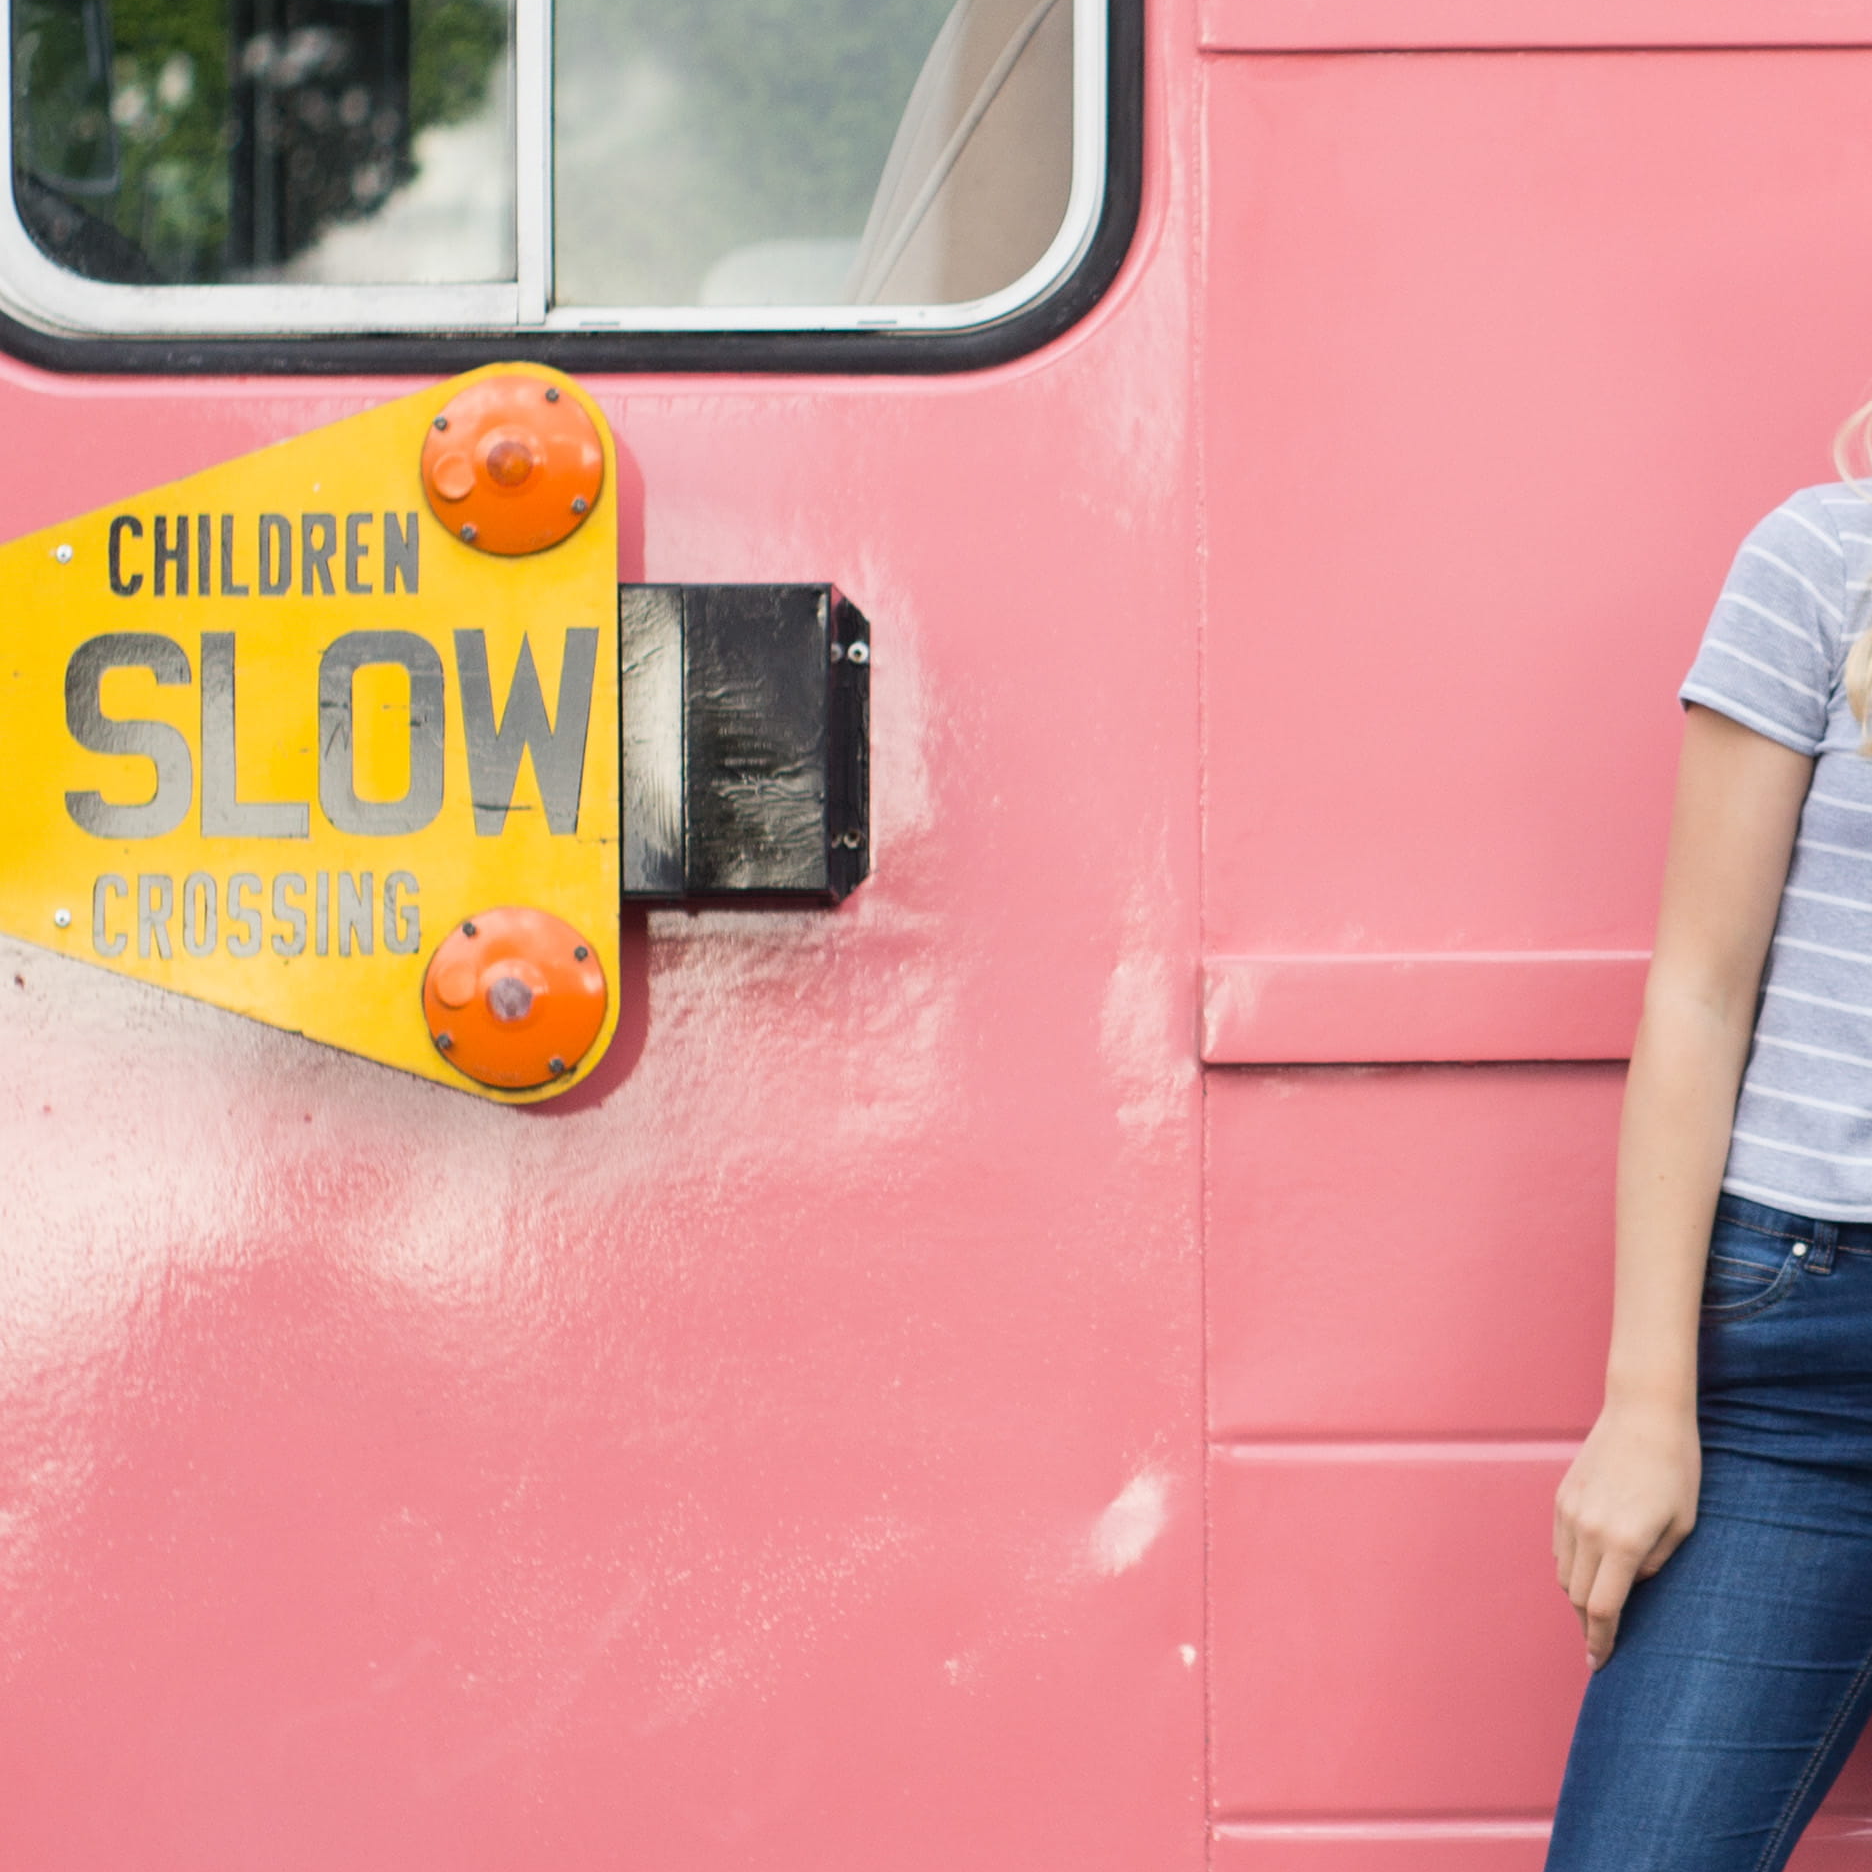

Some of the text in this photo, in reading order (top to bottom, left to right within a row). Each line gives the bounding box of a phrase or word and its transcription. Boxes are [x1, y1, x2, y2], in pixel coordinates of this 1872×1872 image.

[109, 512, 420, 596] CHILDREN
[65, 627, 600, 840] SLOW
[92, 870, 422, 960] CROSSING
